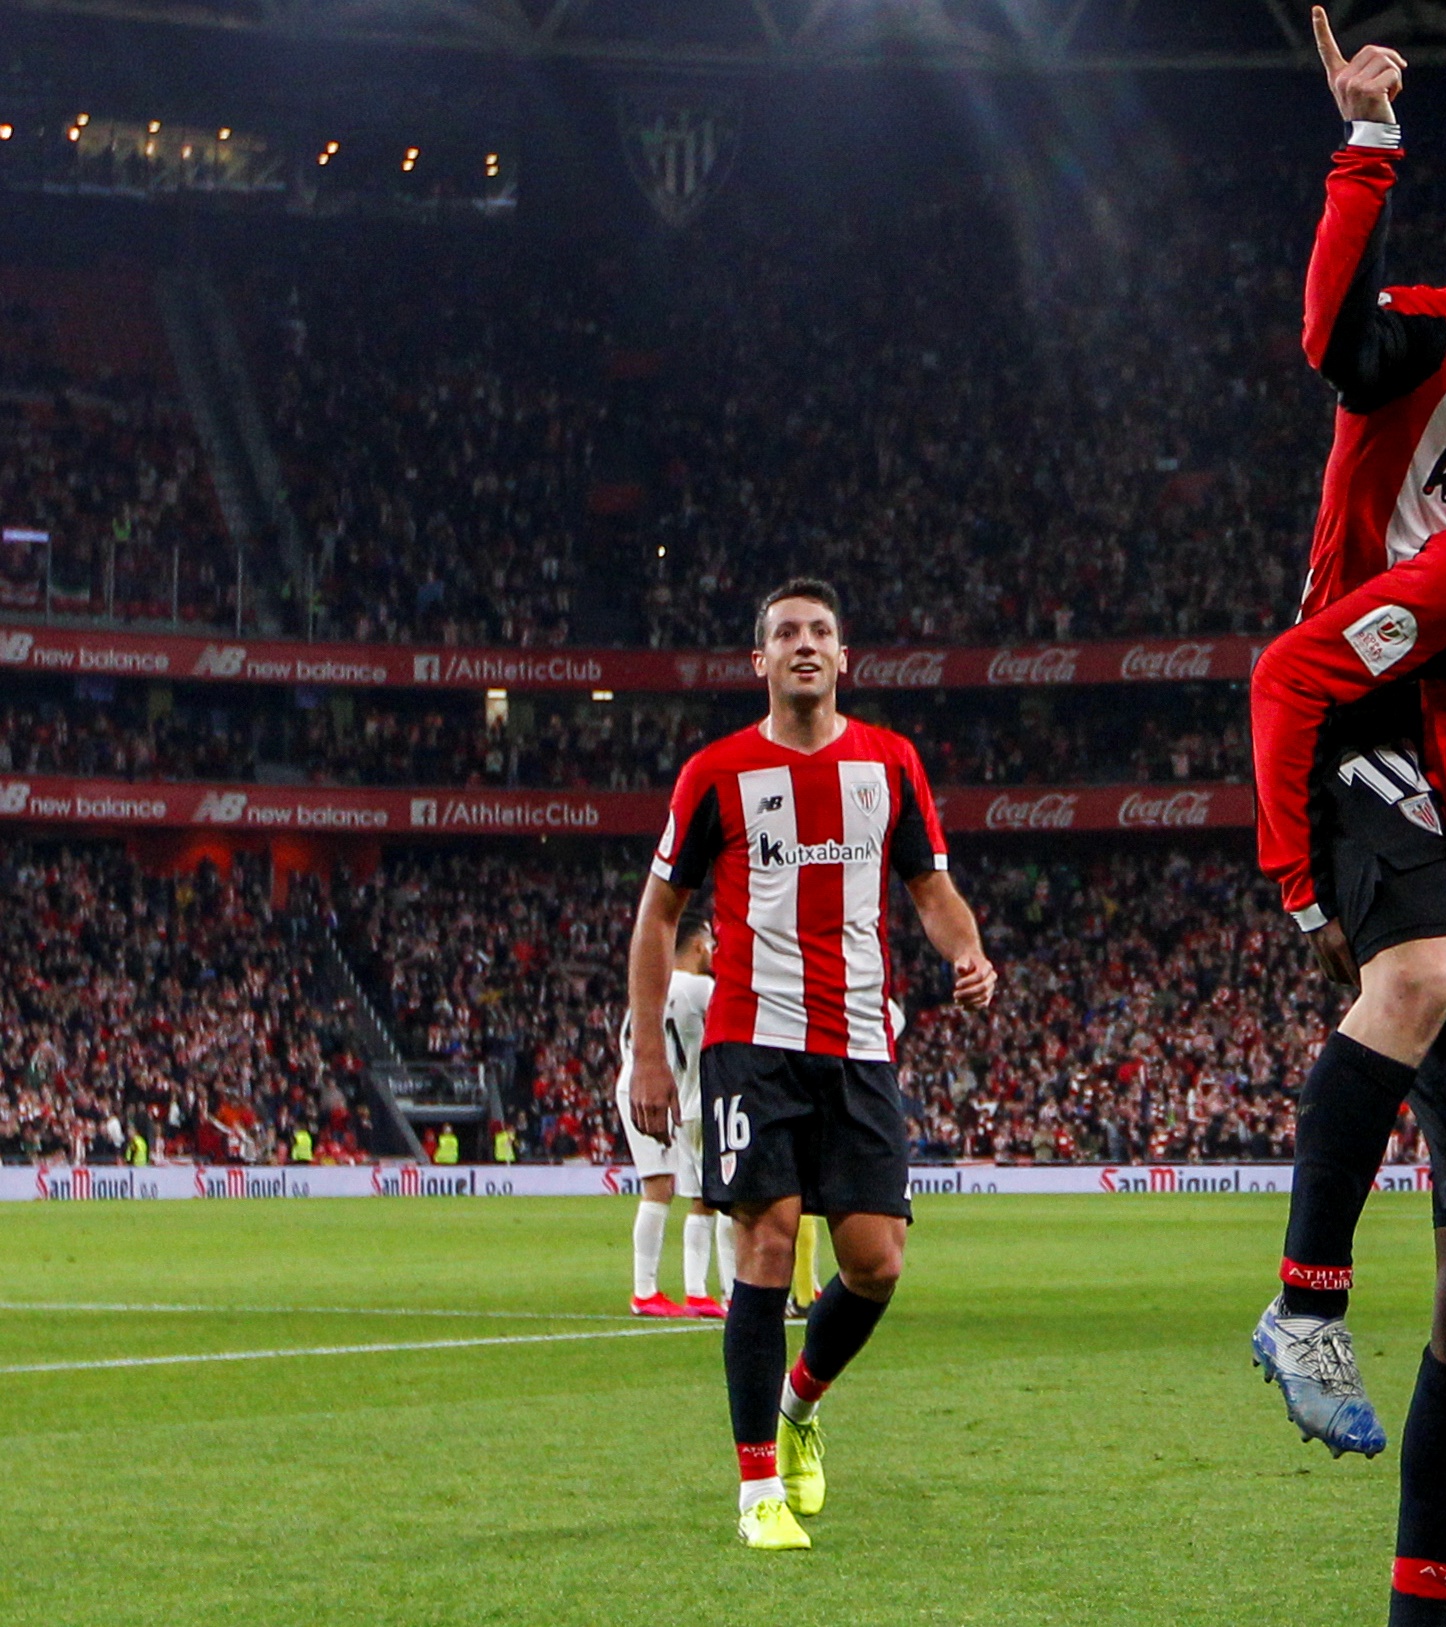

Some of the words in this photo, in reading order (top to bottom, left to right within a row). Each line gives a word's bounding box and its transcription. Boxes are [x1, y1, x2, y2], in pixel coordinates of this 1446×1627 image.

[33, 648, 74, 667] new
[79, 648, 169, 671] balance
[247, 661, 292, 680] new
[299, 660, 388, 682] balance
[30, 798, 71, 817] new
[77, 797, 167, 819] balance
[248, 806, 292, 824] new
[298, 803, 388, 827] balance
[713, 1094, 751, 1153] 16
